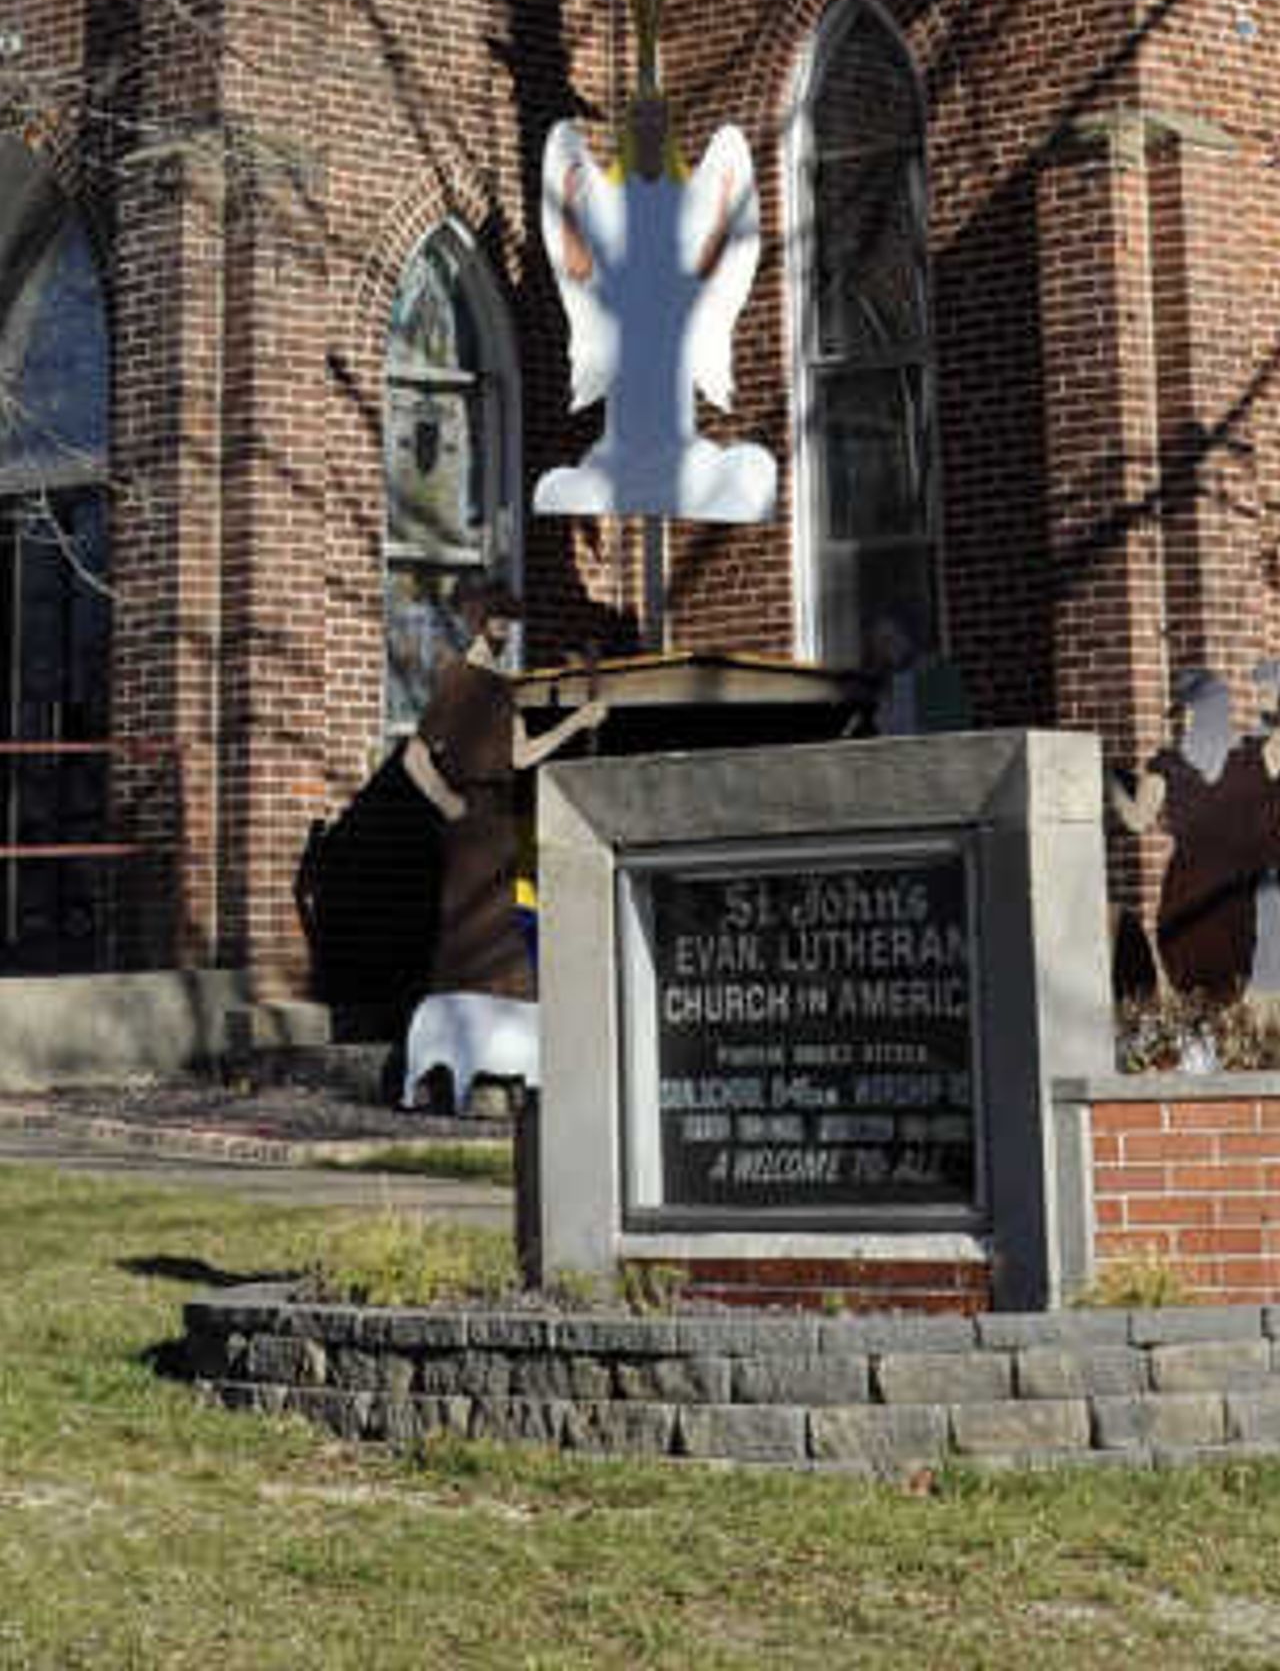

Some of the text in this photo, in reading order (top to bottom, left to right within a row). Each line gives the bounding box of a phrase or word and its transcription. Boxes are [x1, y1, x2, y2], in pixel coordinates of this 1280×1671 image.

[674, 923, 969, 976] EVAN. LUTHERAN
[663, 983, 792, 1024] CHURCH
[836, 978, 970, 1022] AMERIC
